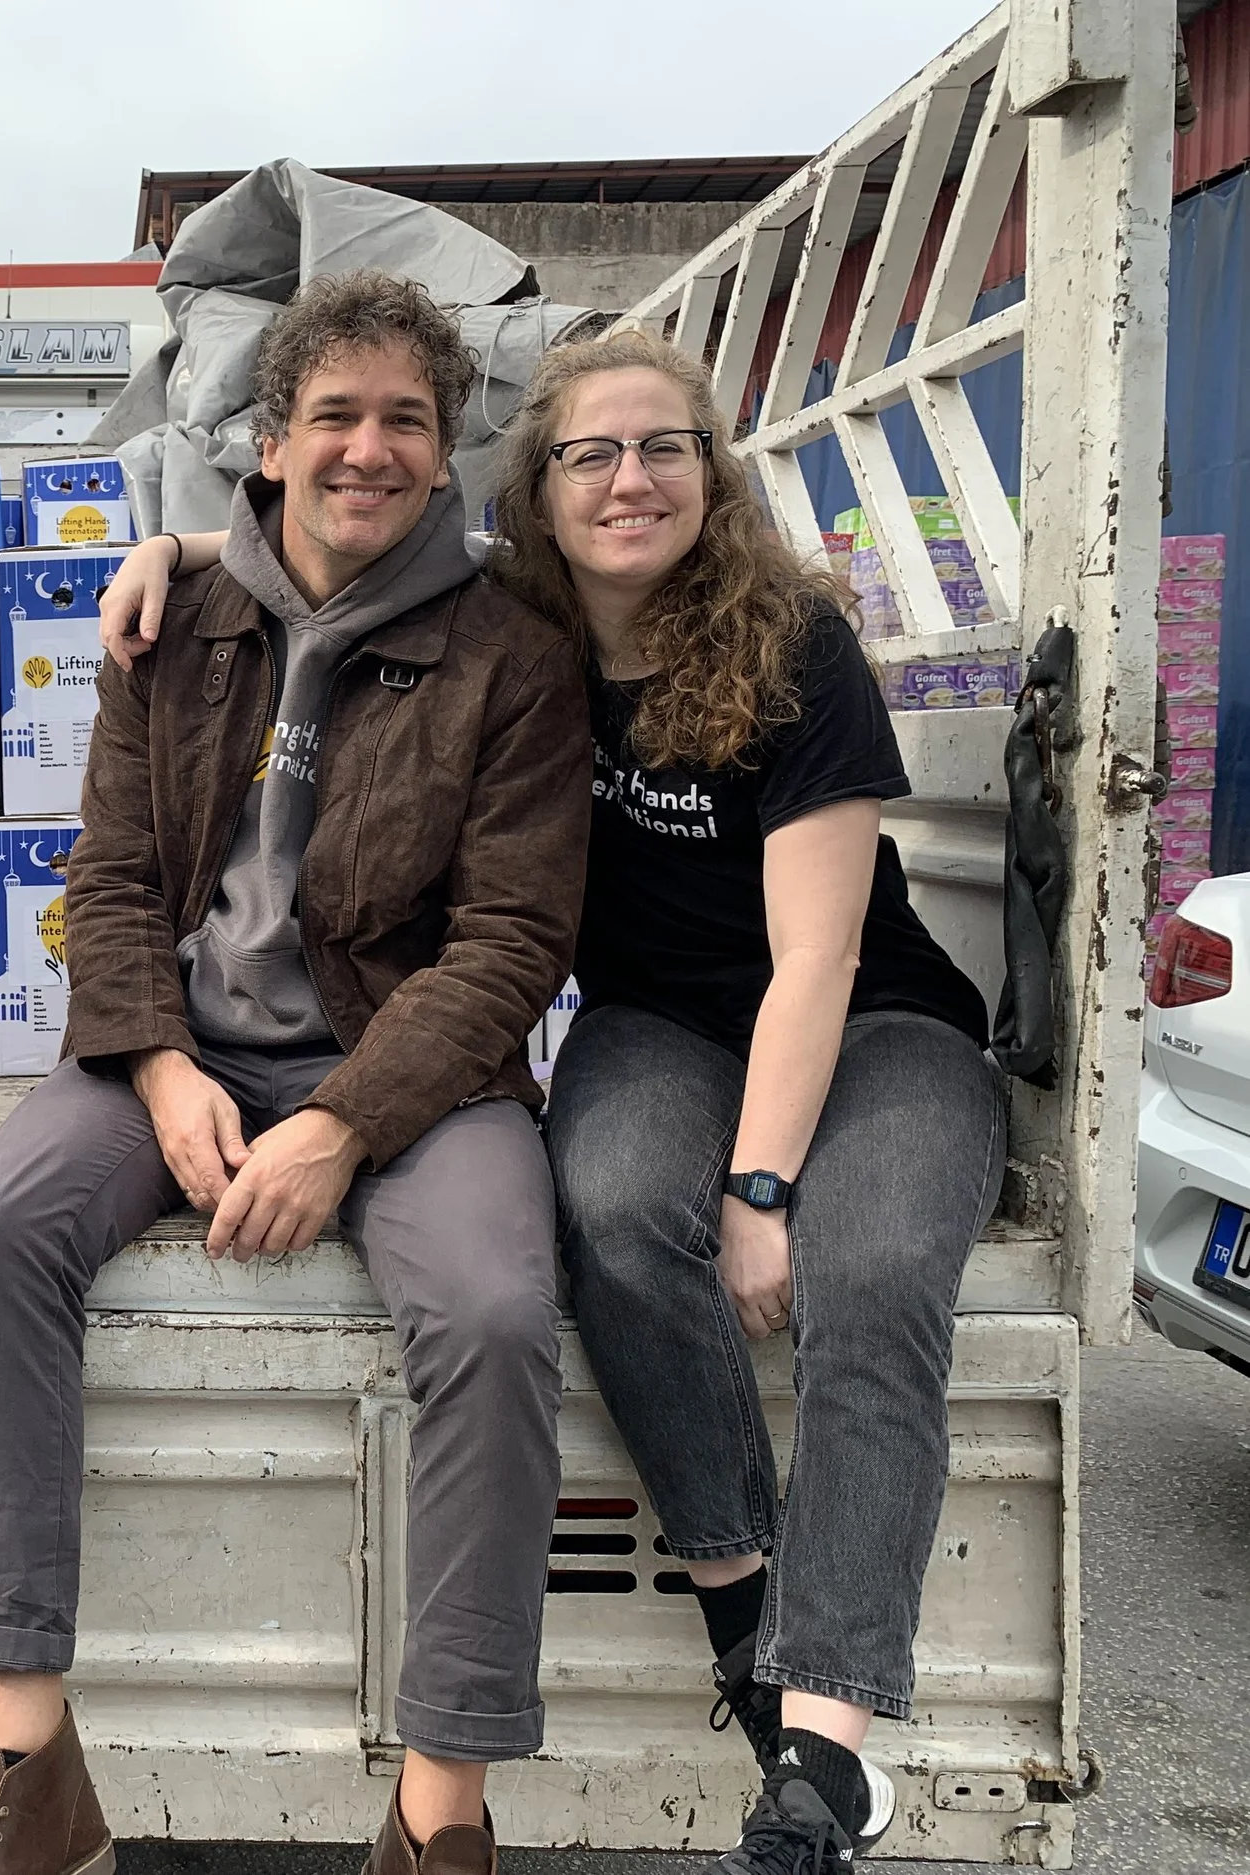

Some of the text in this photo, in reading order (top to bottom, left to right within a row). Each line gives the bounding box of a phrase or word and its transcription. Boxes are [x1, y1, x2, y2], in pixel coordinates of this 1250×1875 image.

[56, 516, 110, 528] Lifting Hands
[56, 526, 110, 535] International
[56, 655, 102, 674] Lifting
[914, 672, 948, 684] Gofret
[965, 672, 998, 683] Gofret
[630, 769, 713, 812] Hands
[1213, 1243, 1230, 1264] TR
